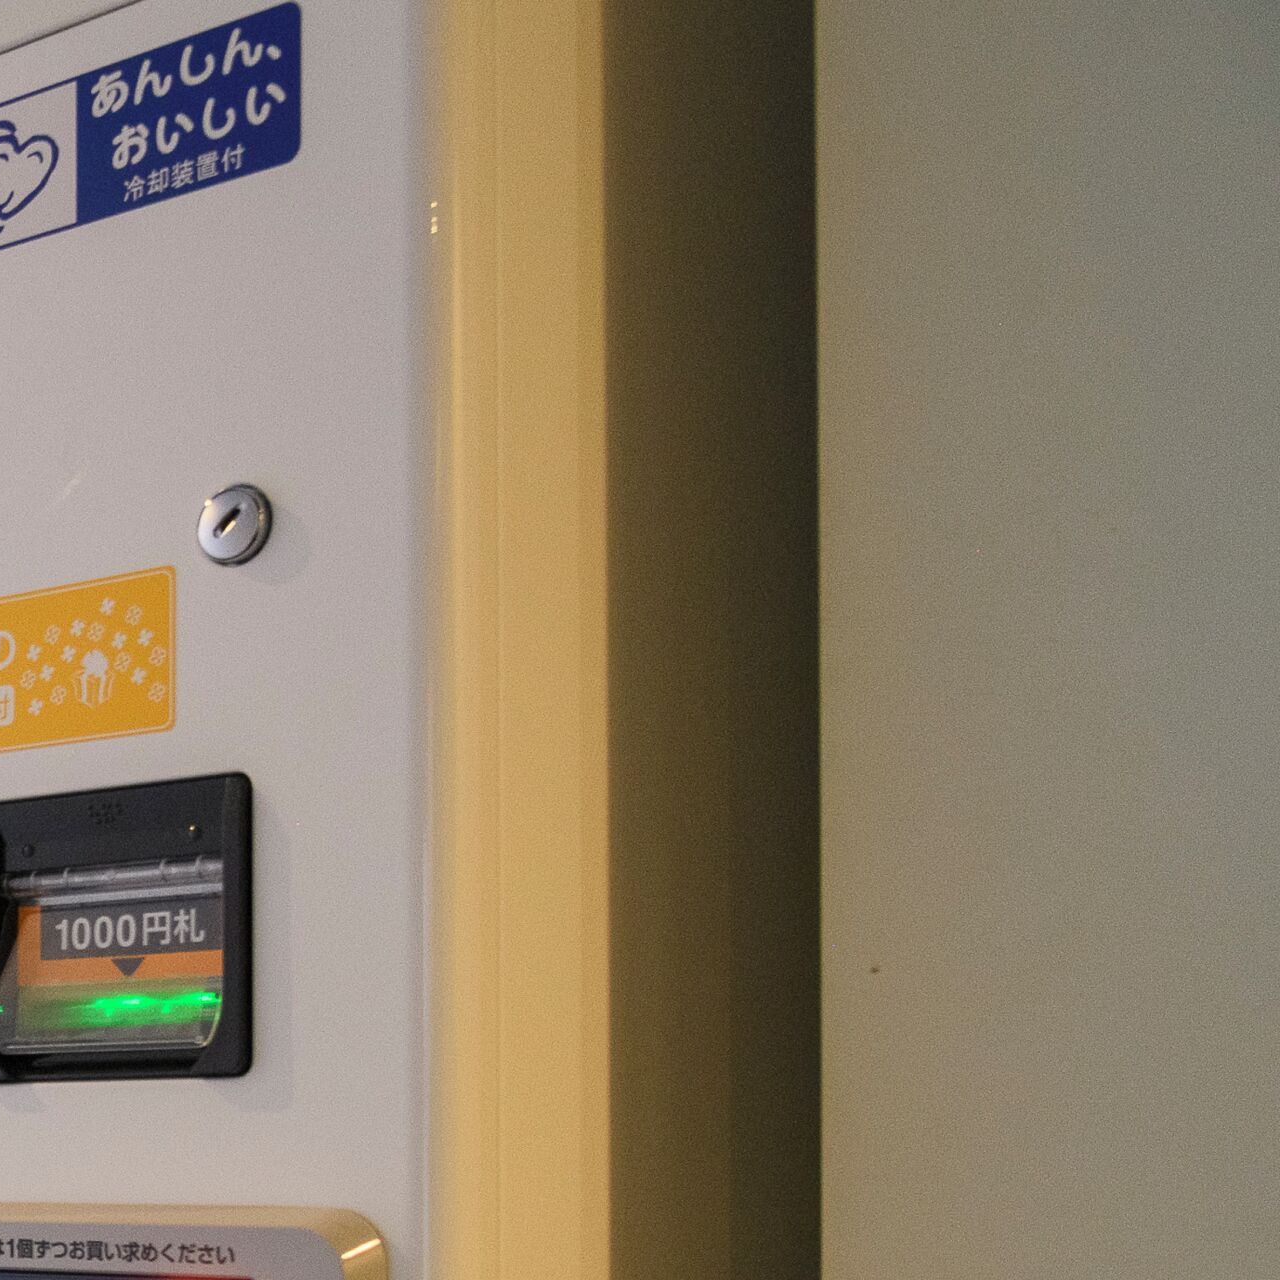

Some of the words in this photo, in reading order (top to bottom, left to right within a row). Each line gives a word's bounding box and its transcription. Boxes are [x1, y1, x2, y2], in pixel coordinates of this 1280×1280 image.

[90, 27, 282, 118] あんしん、
[111, 83, 286, 170] おいしい
[122, 145, 245, 202] 冷却装置付
[55, 909, 205, 950] 1000円札
